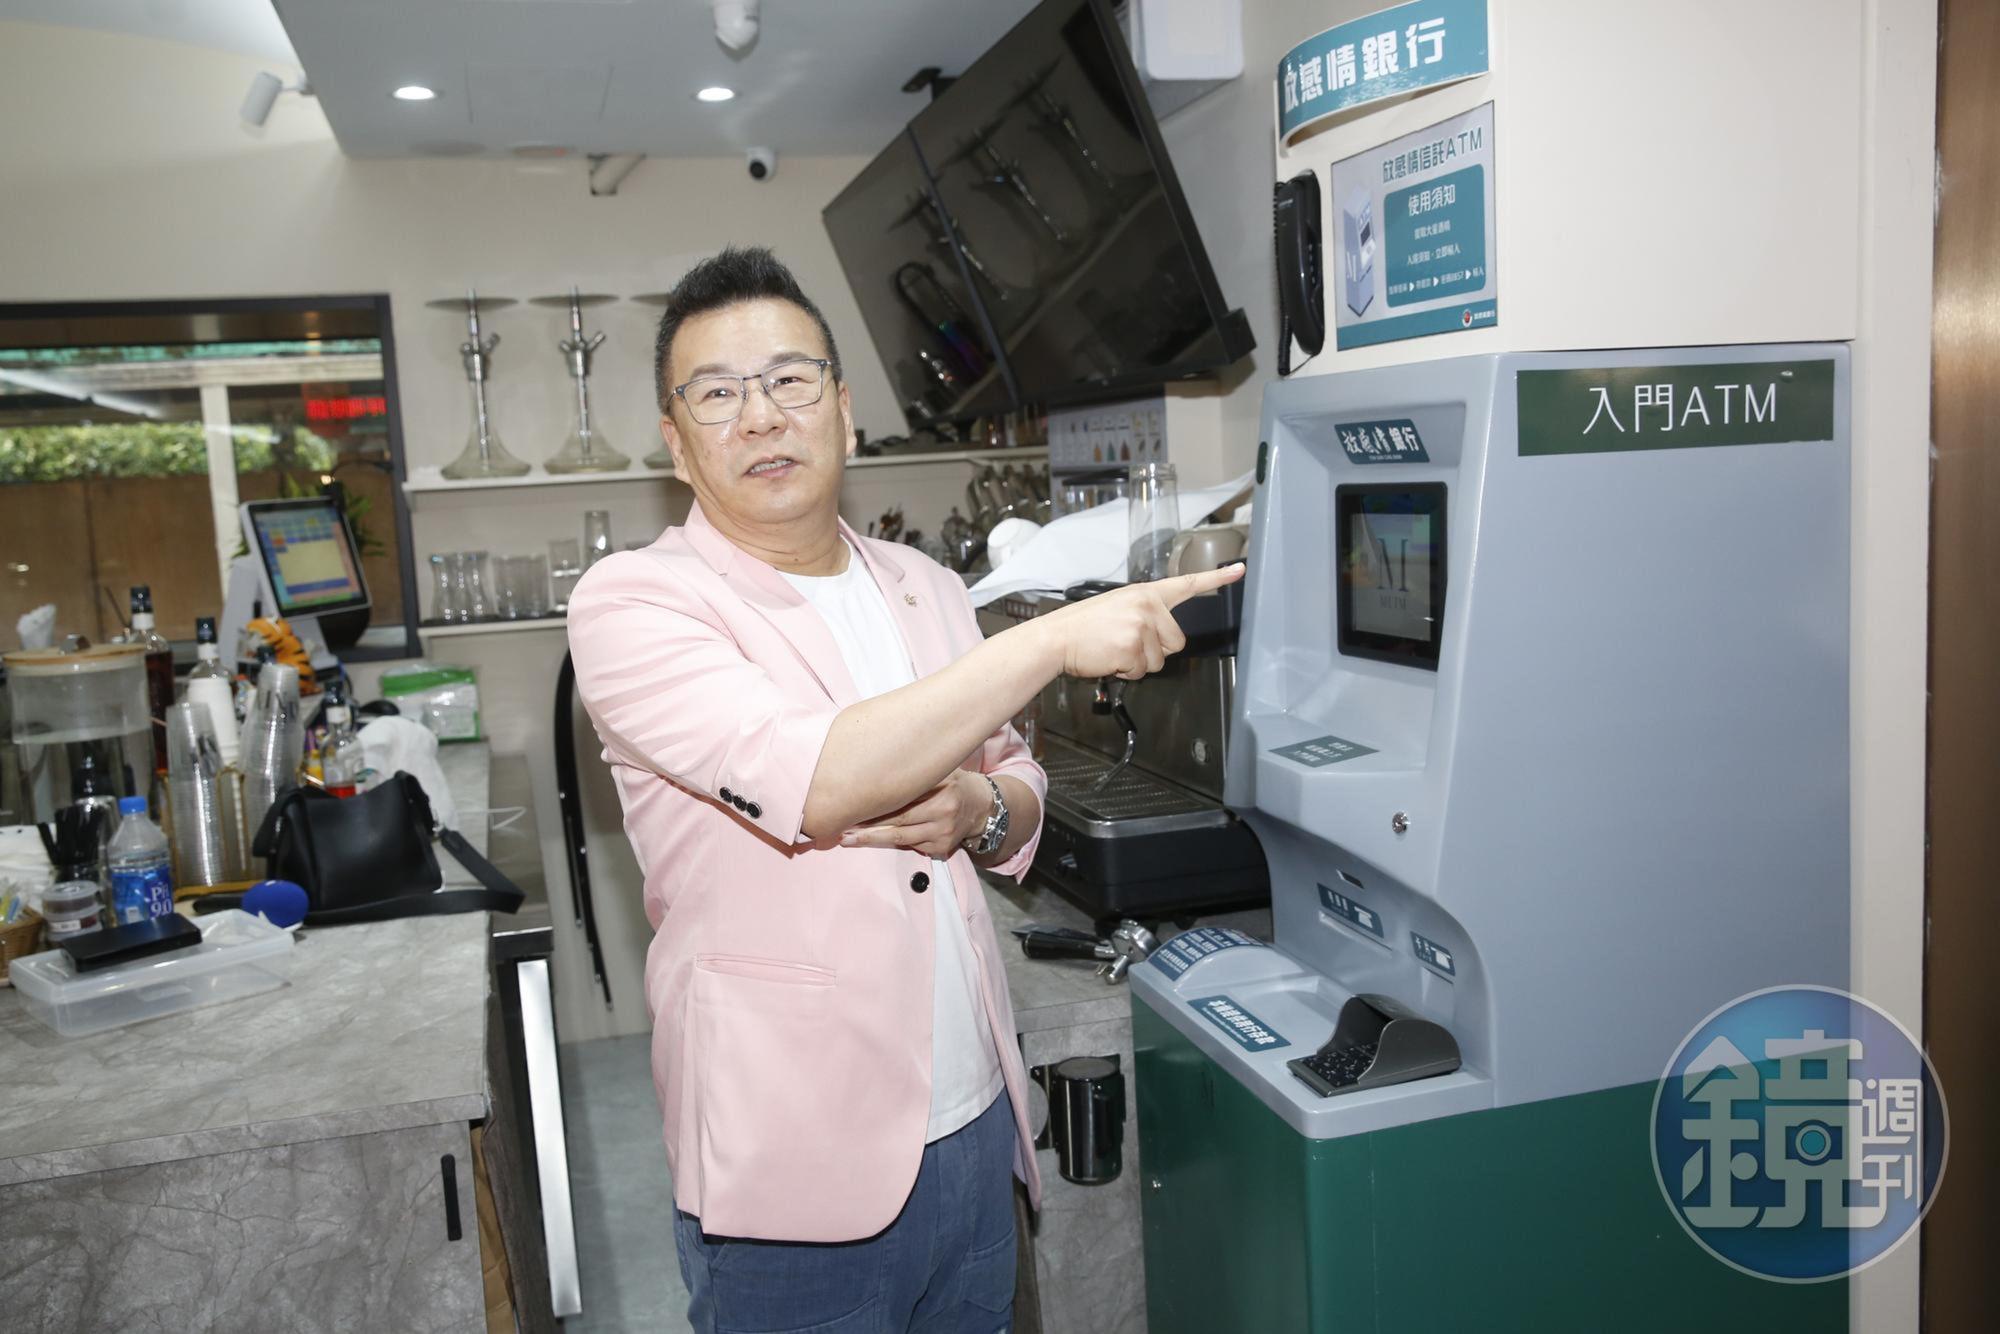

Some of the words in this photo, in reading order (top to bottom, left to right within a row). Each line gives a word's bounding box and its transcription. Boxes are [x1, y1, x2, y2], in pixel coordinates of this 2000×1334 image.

[1284, 17, 1446, 113] 放感情銀行
[1382, 126, 1483, 184] 放感情信託ATM
[1407, 183, 1456, 217] 使用須知
[1582, 382, 1777, 433] 入門ATM
